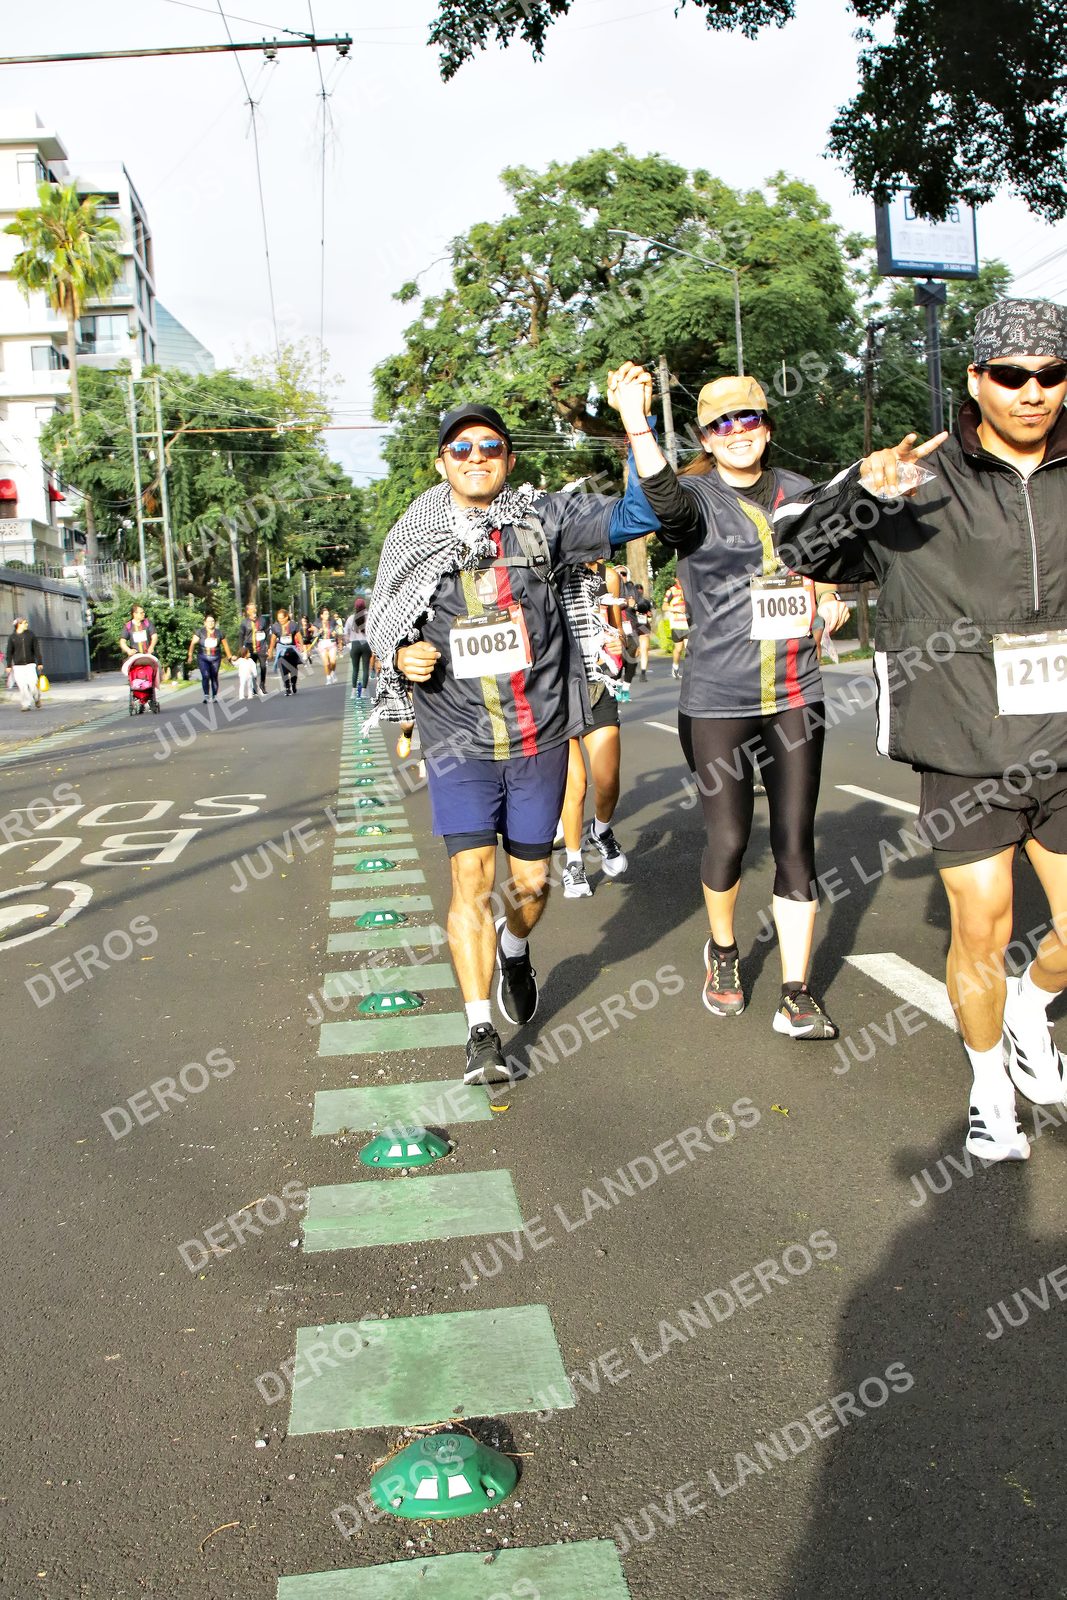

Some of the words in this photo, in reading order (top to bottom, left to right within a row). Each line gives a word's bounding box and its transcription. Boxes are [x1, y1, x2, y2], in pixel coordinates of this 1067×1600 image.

[757, 595, 807, 618] 10083
[454, 629, 519, 657] 10082
[1001, 655, 1067, 687] 1219
